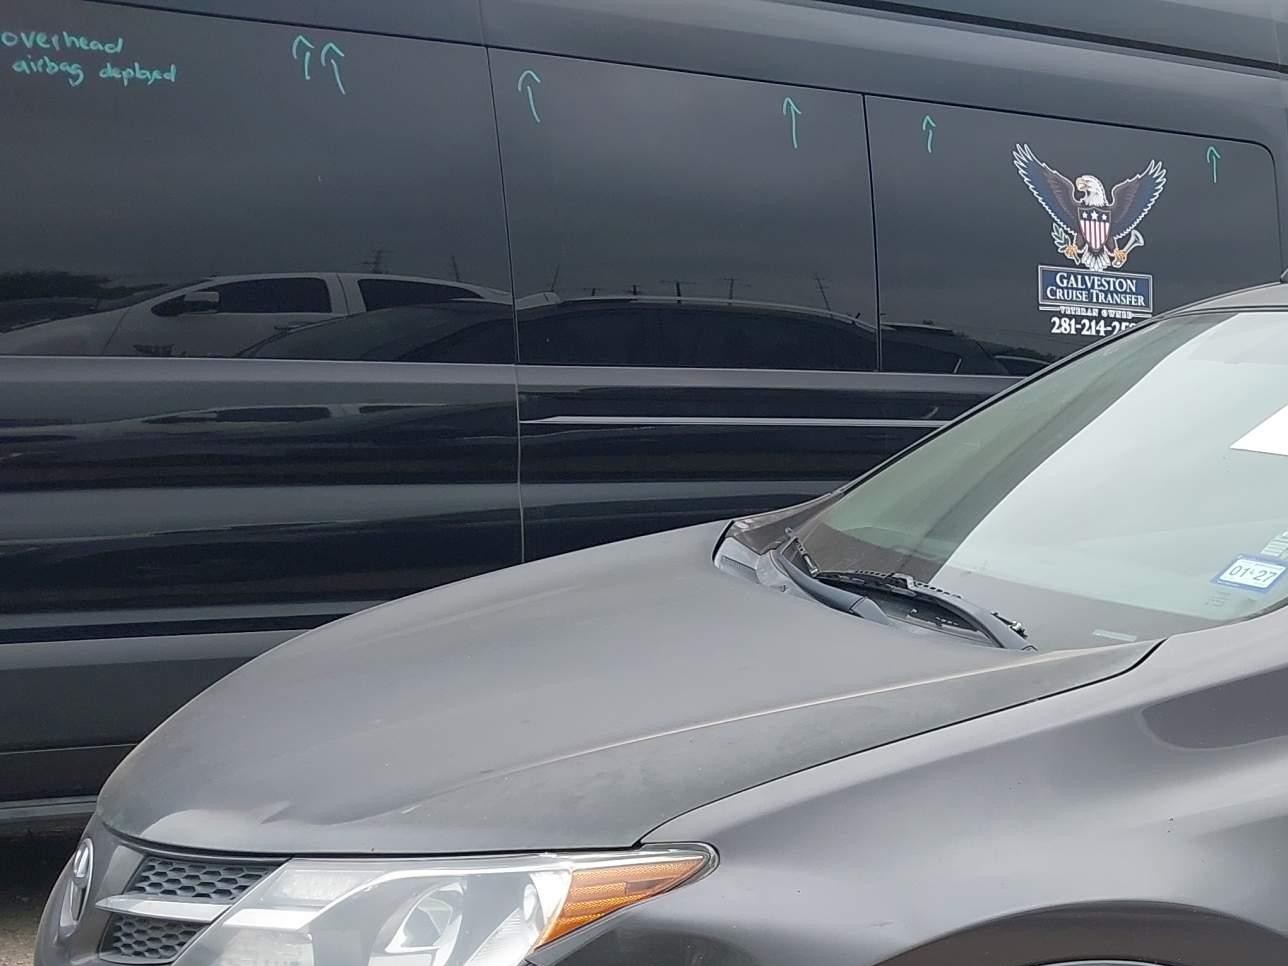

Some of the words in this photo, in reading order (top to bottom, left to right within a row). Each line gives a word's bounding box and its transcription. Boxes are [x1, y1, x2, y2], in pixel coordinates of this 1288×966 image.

[1, 31, 124, 53] overhead
[12, 55, 84, 87] airbag
[1055, 272, 1137, 293] GALVESTON
[1046, 286, 1089, 302] CRUISE
[1090, 289, 1146, 307] TRANSFER
